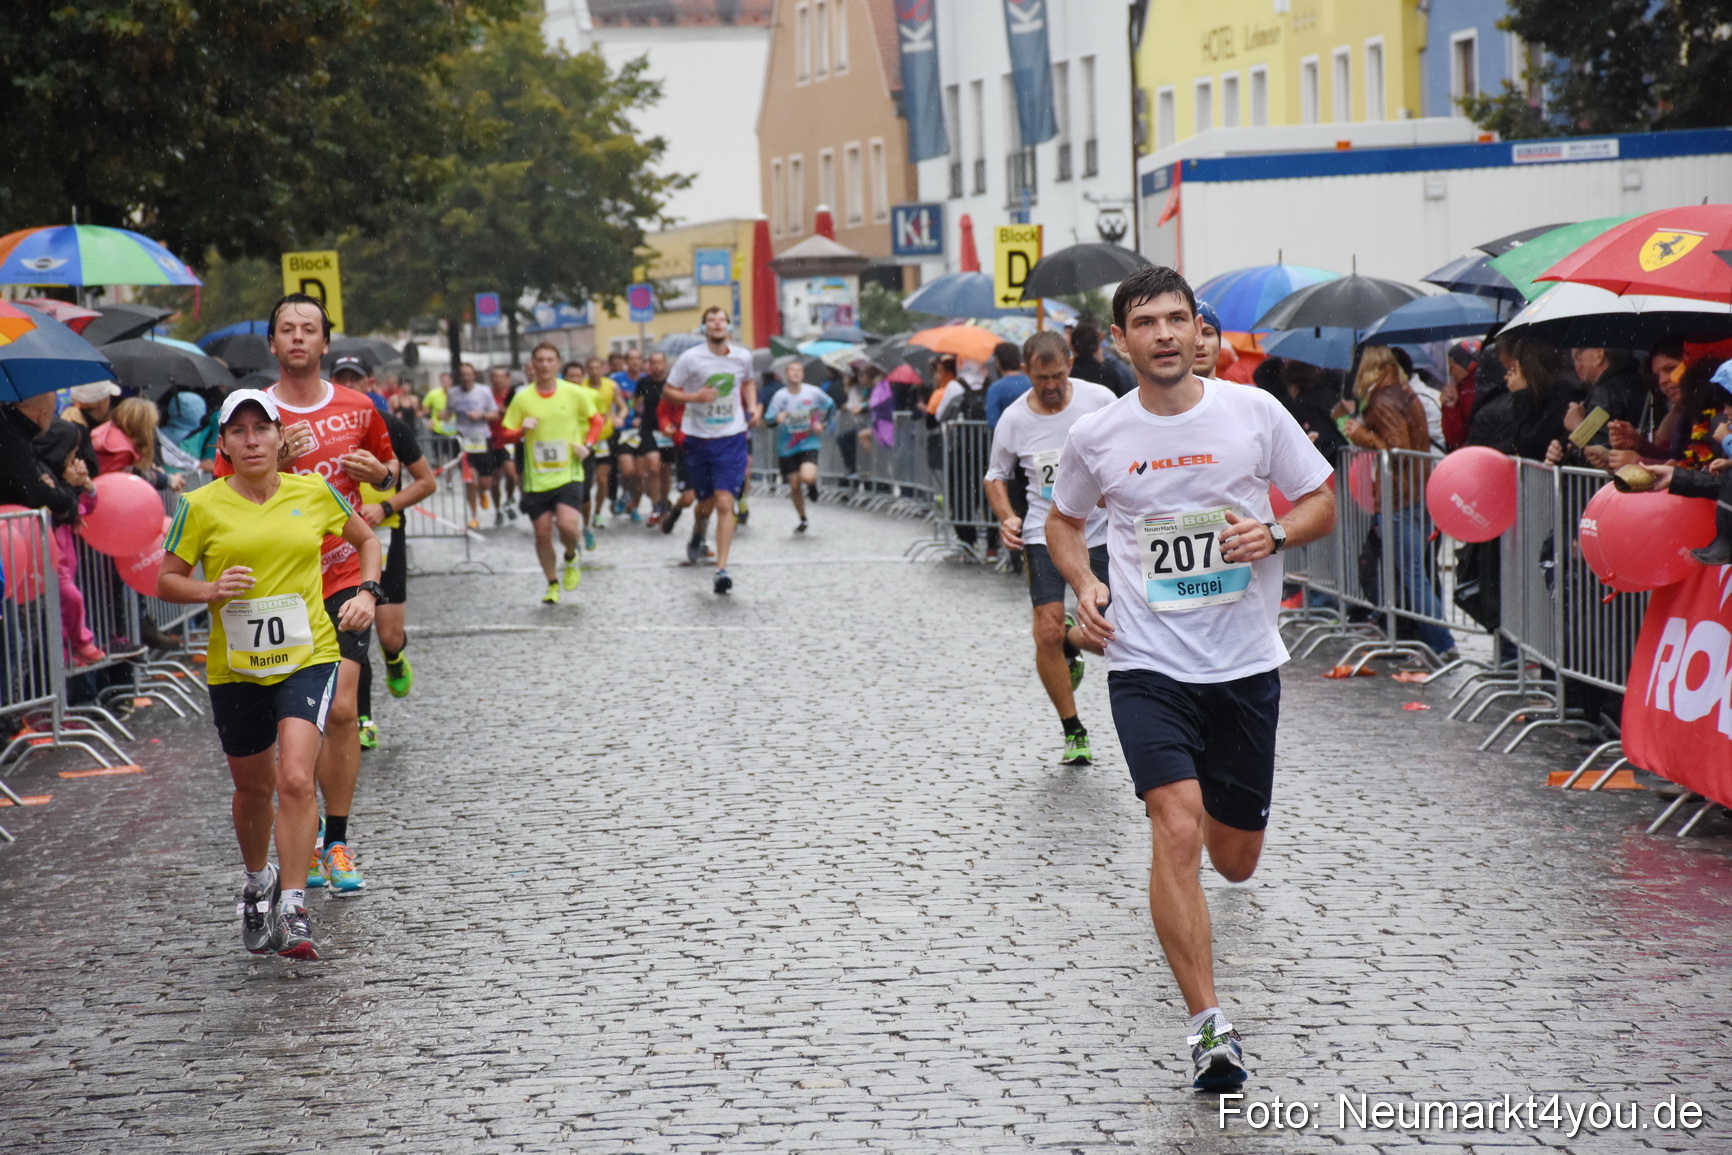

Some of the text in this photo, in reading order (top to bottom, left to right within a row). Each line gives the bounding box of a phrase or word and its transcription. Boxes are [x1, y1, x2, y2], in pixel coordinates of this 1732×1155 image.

[1000, 229, 1039, 244] Block
[289, 256, 331, 272] Block
[1008, 250, 1031, 288] D
[1151, 454, 1219, 471] KLEBL
[1144, 524, 1178, 534] NeuerMarkt
[1176, 576, 1223, 597] Sergej
[257, 596, 299, 611] BOCK
[247, 616, 285, 648] 70
[249, 653, 289, 667] Marion
